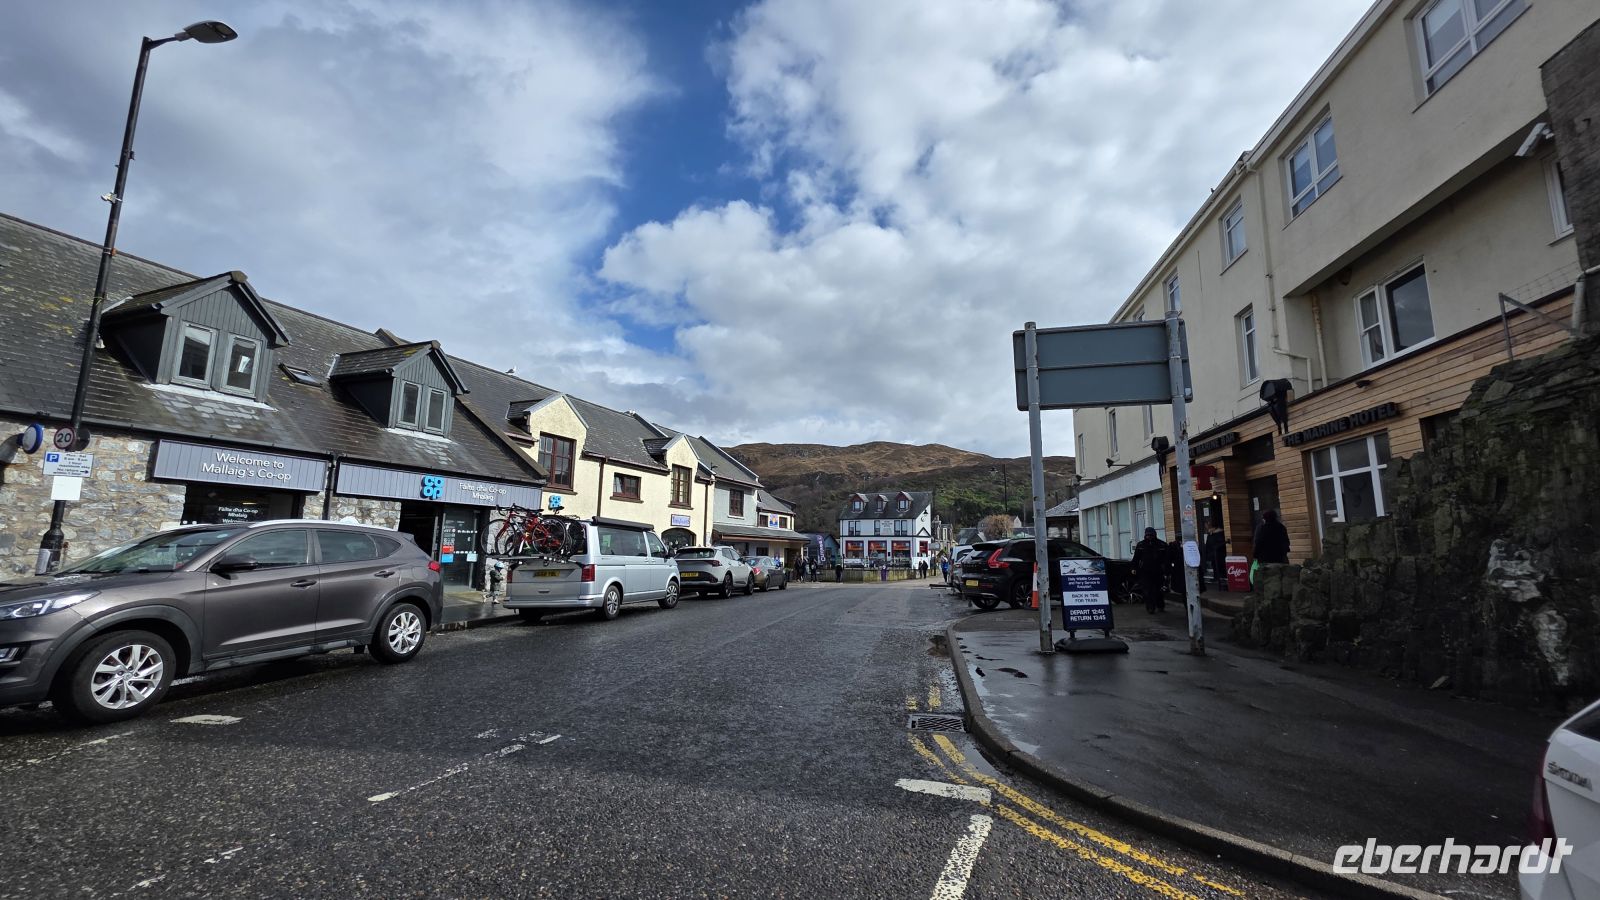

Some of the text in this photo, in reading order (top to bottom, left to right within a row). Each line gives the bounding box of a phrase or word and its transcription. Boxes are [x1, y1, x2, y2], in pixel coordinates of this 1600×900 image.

[1303, 417, 1349, 442] MARINE
[1350, 402, 1396, 428] HOTEL
[57, 432, 72, 443] 20
[216, 452, 284, 469] Welcome to
[202, 463, 291, 483] Mallaig's Co-op
[489, 485, 506, 495] Co-op
